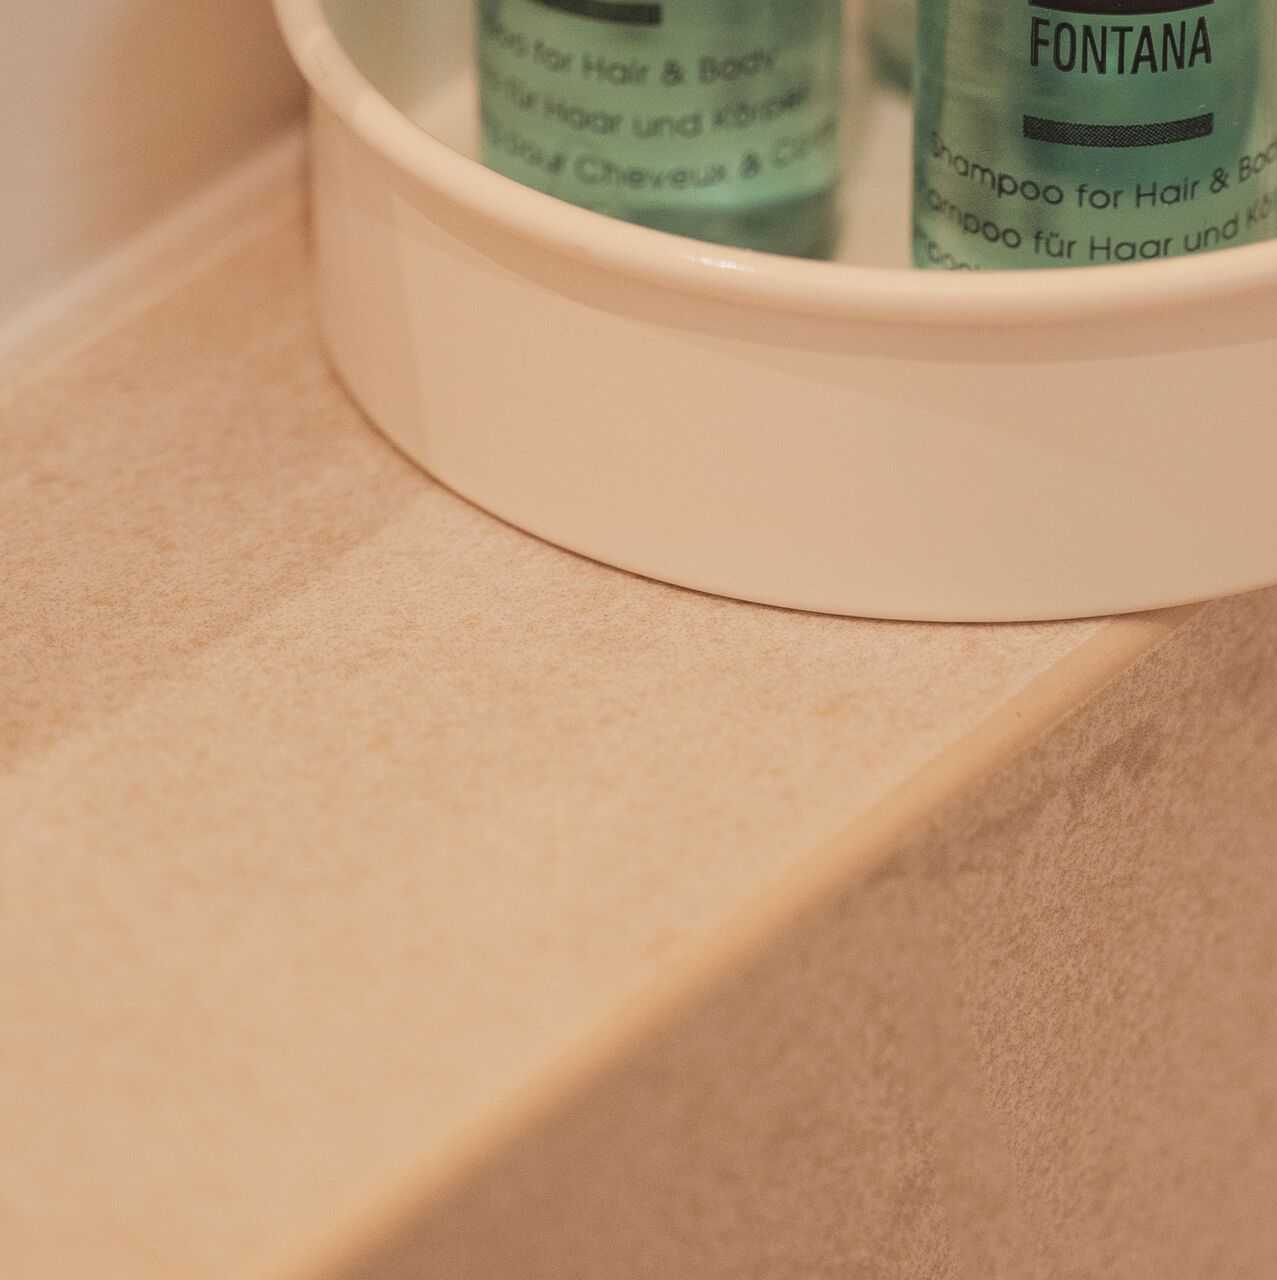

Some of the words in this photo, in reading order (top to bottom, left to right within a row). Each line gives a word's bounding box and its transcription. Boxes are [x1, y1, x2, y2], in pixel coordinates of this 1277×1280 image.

[1029, 15, 1213, 76] FONTANA
[1076, 184, 1124, 210] for
[1135, 177, 1200, 209] Hair
[1209, 167, 1230, 194] &
[1034, 230, 1077, 260] für
[1089, 235, 1173, 262] Haar
[1184, 211, 1240, 253] und
